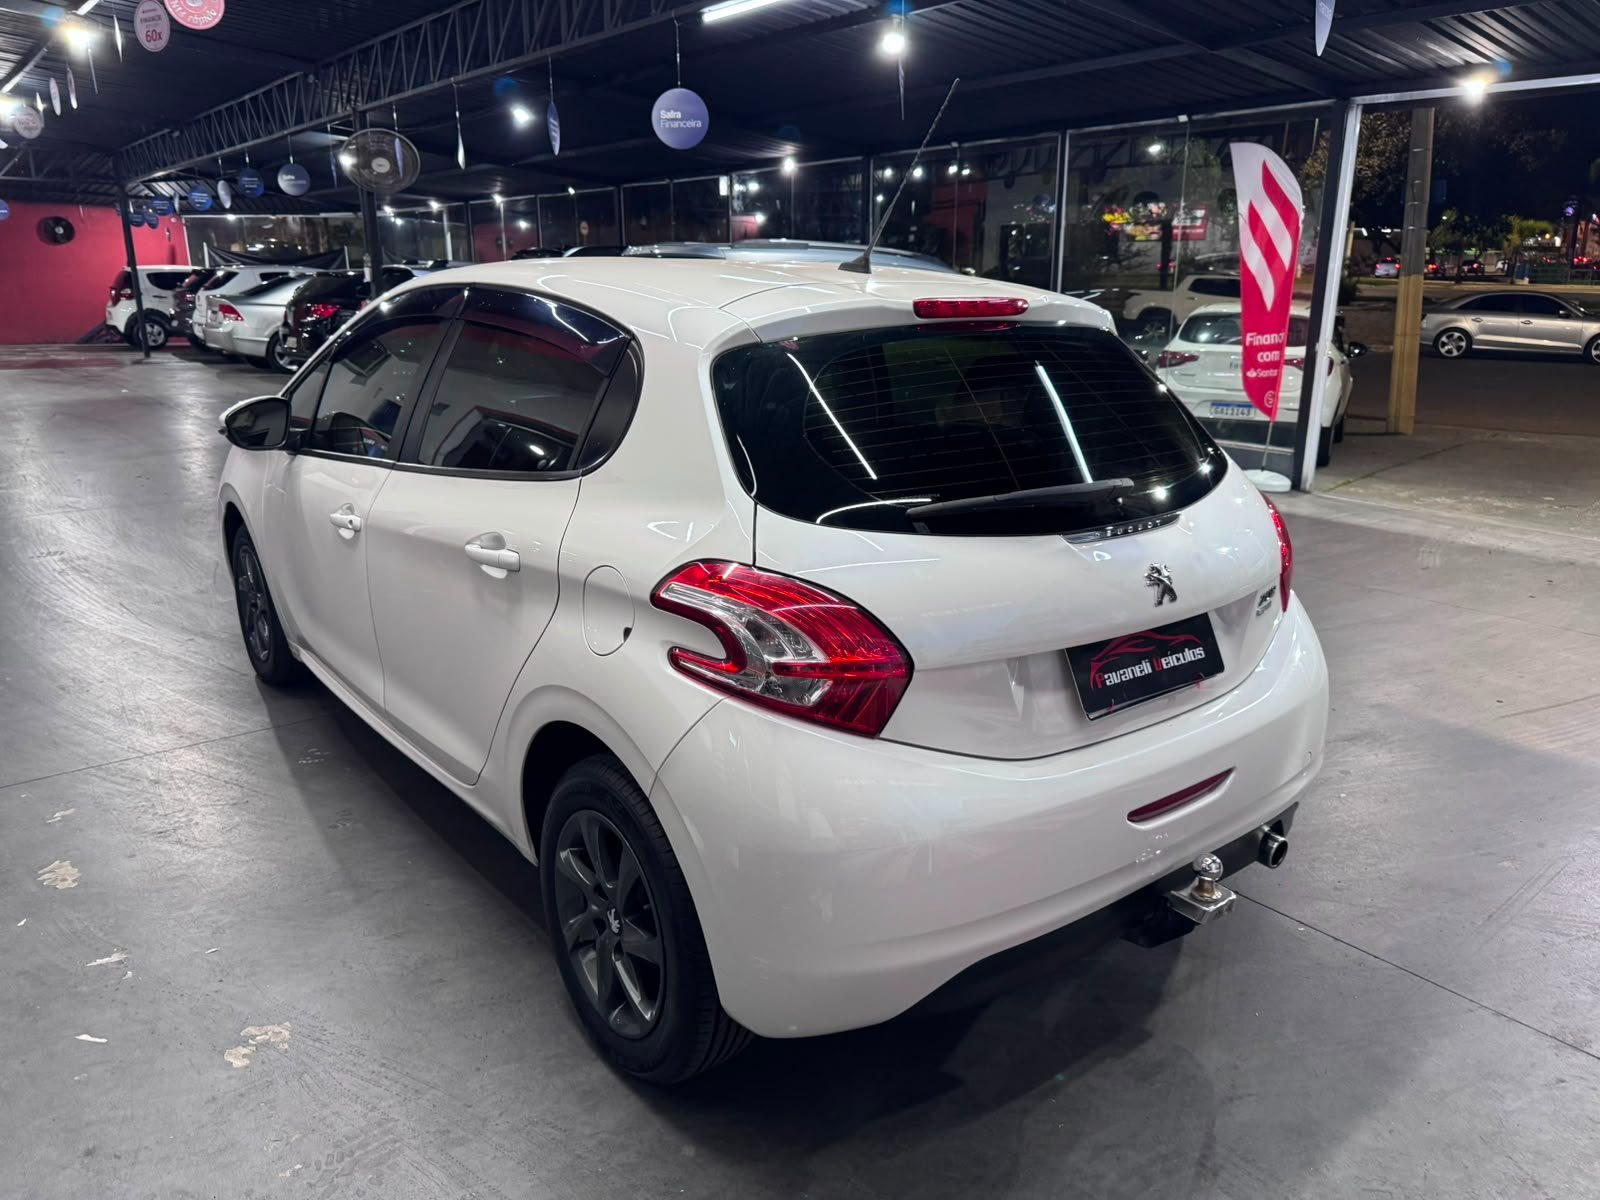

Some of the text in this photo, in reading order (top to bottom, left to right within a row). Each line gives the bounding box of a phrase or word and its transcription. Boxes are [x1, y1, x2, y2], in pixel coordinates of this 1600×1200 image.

[145, 29, 162, 42] 60x
[659, 109, 682, 119] Safra
[660, 119, 702, 128] Financeira
[1257, 350, 1280, 362] com
[1095, 646, 1205, 688] Pavaneli Veículos
